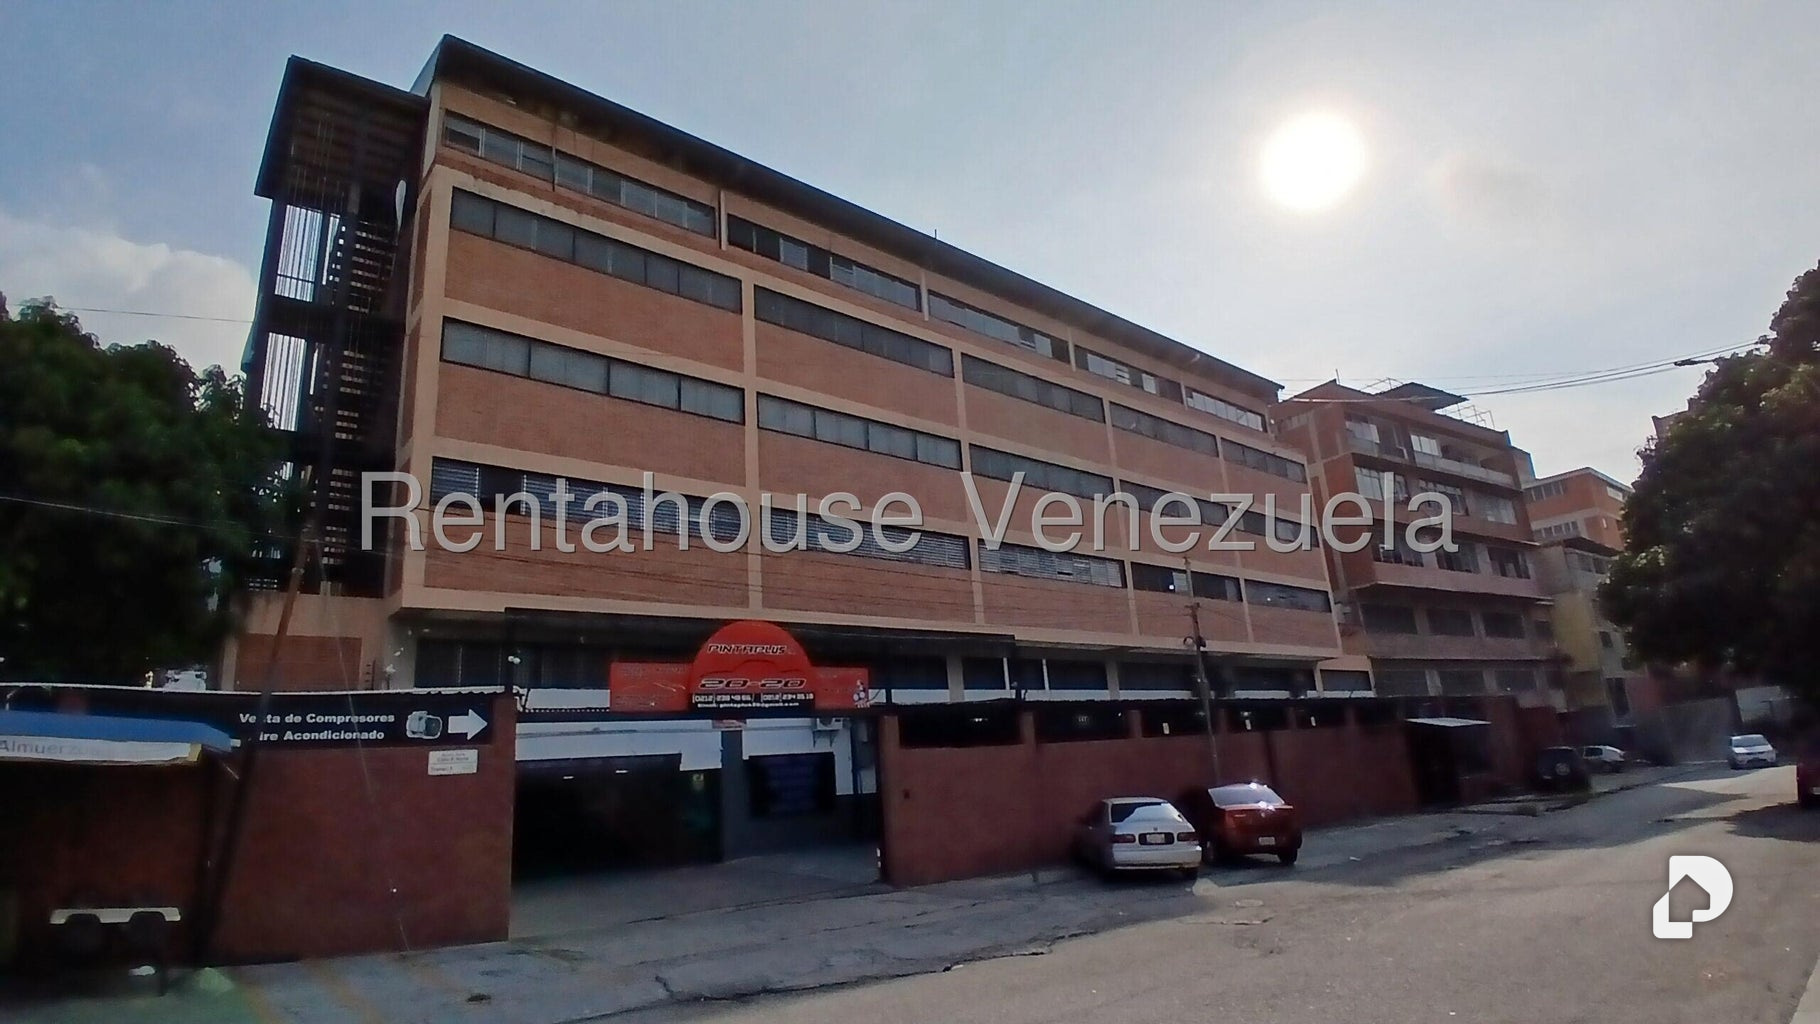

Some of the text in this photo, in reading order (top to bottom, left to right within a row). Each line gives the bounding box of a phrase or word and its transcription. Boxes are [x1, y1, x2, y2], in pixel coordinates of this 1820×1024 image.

[708, 643, 787, 655] PINTAPLUS
[698, 678, 806, 690] 20-20
[239, 713, 396, 725] Veta de Compresores
[258, 730, 386, 742] ire Acondicionado
